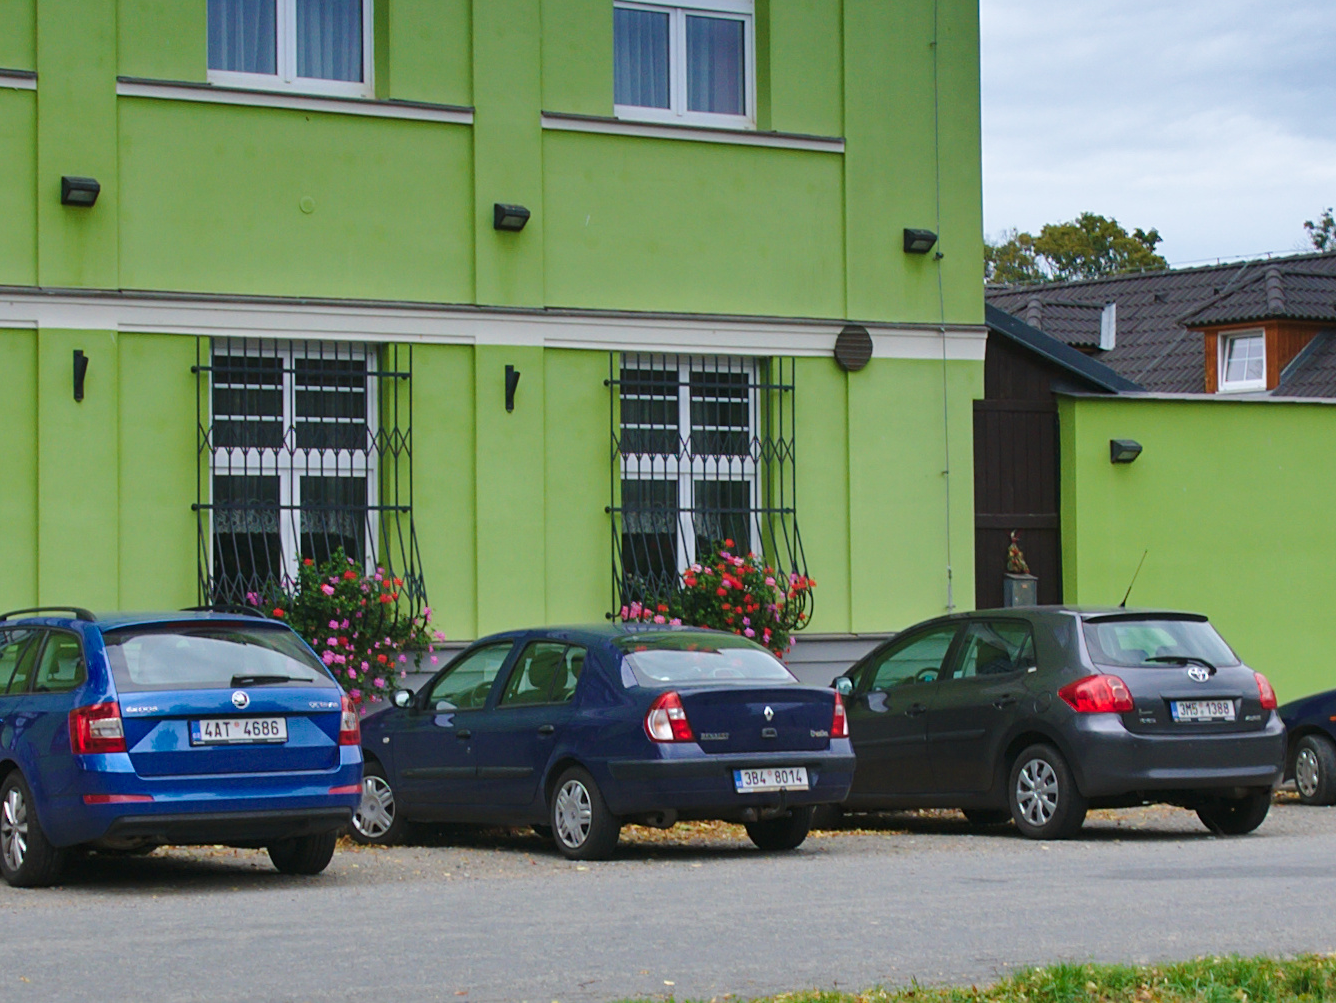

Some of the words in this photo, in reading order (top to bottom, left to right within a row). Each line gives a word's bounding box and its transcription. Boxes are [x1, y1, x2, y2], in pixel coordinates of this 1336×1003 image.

[204, 723, 230, 738] 4AT
[243, 721, 280, 736] 4686
[744, 770, 766, 786] 3B4
[774, 769, 802, 783] 8014
